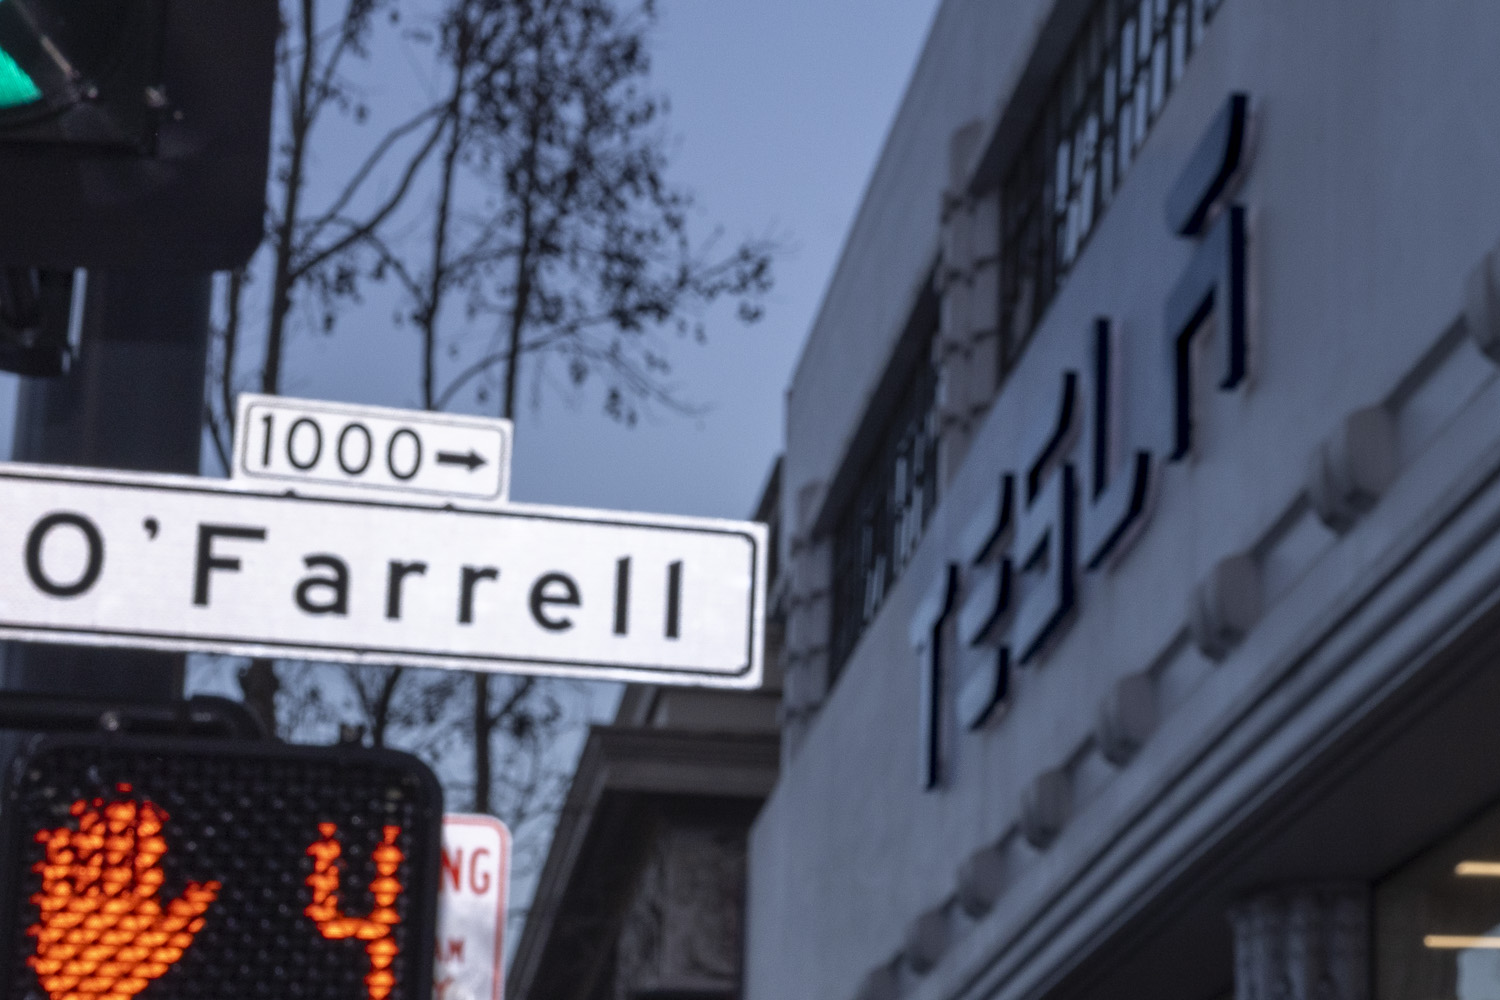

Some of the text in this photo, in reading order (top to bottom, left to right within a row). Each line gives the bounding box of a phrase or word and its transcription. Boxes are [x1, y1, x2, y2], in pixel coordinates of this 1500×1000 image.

[260, 415, 424, 482] 1000
[910, 93, 1250, 792] TESLA
[24, 511, 683, 641] O'Farrell
